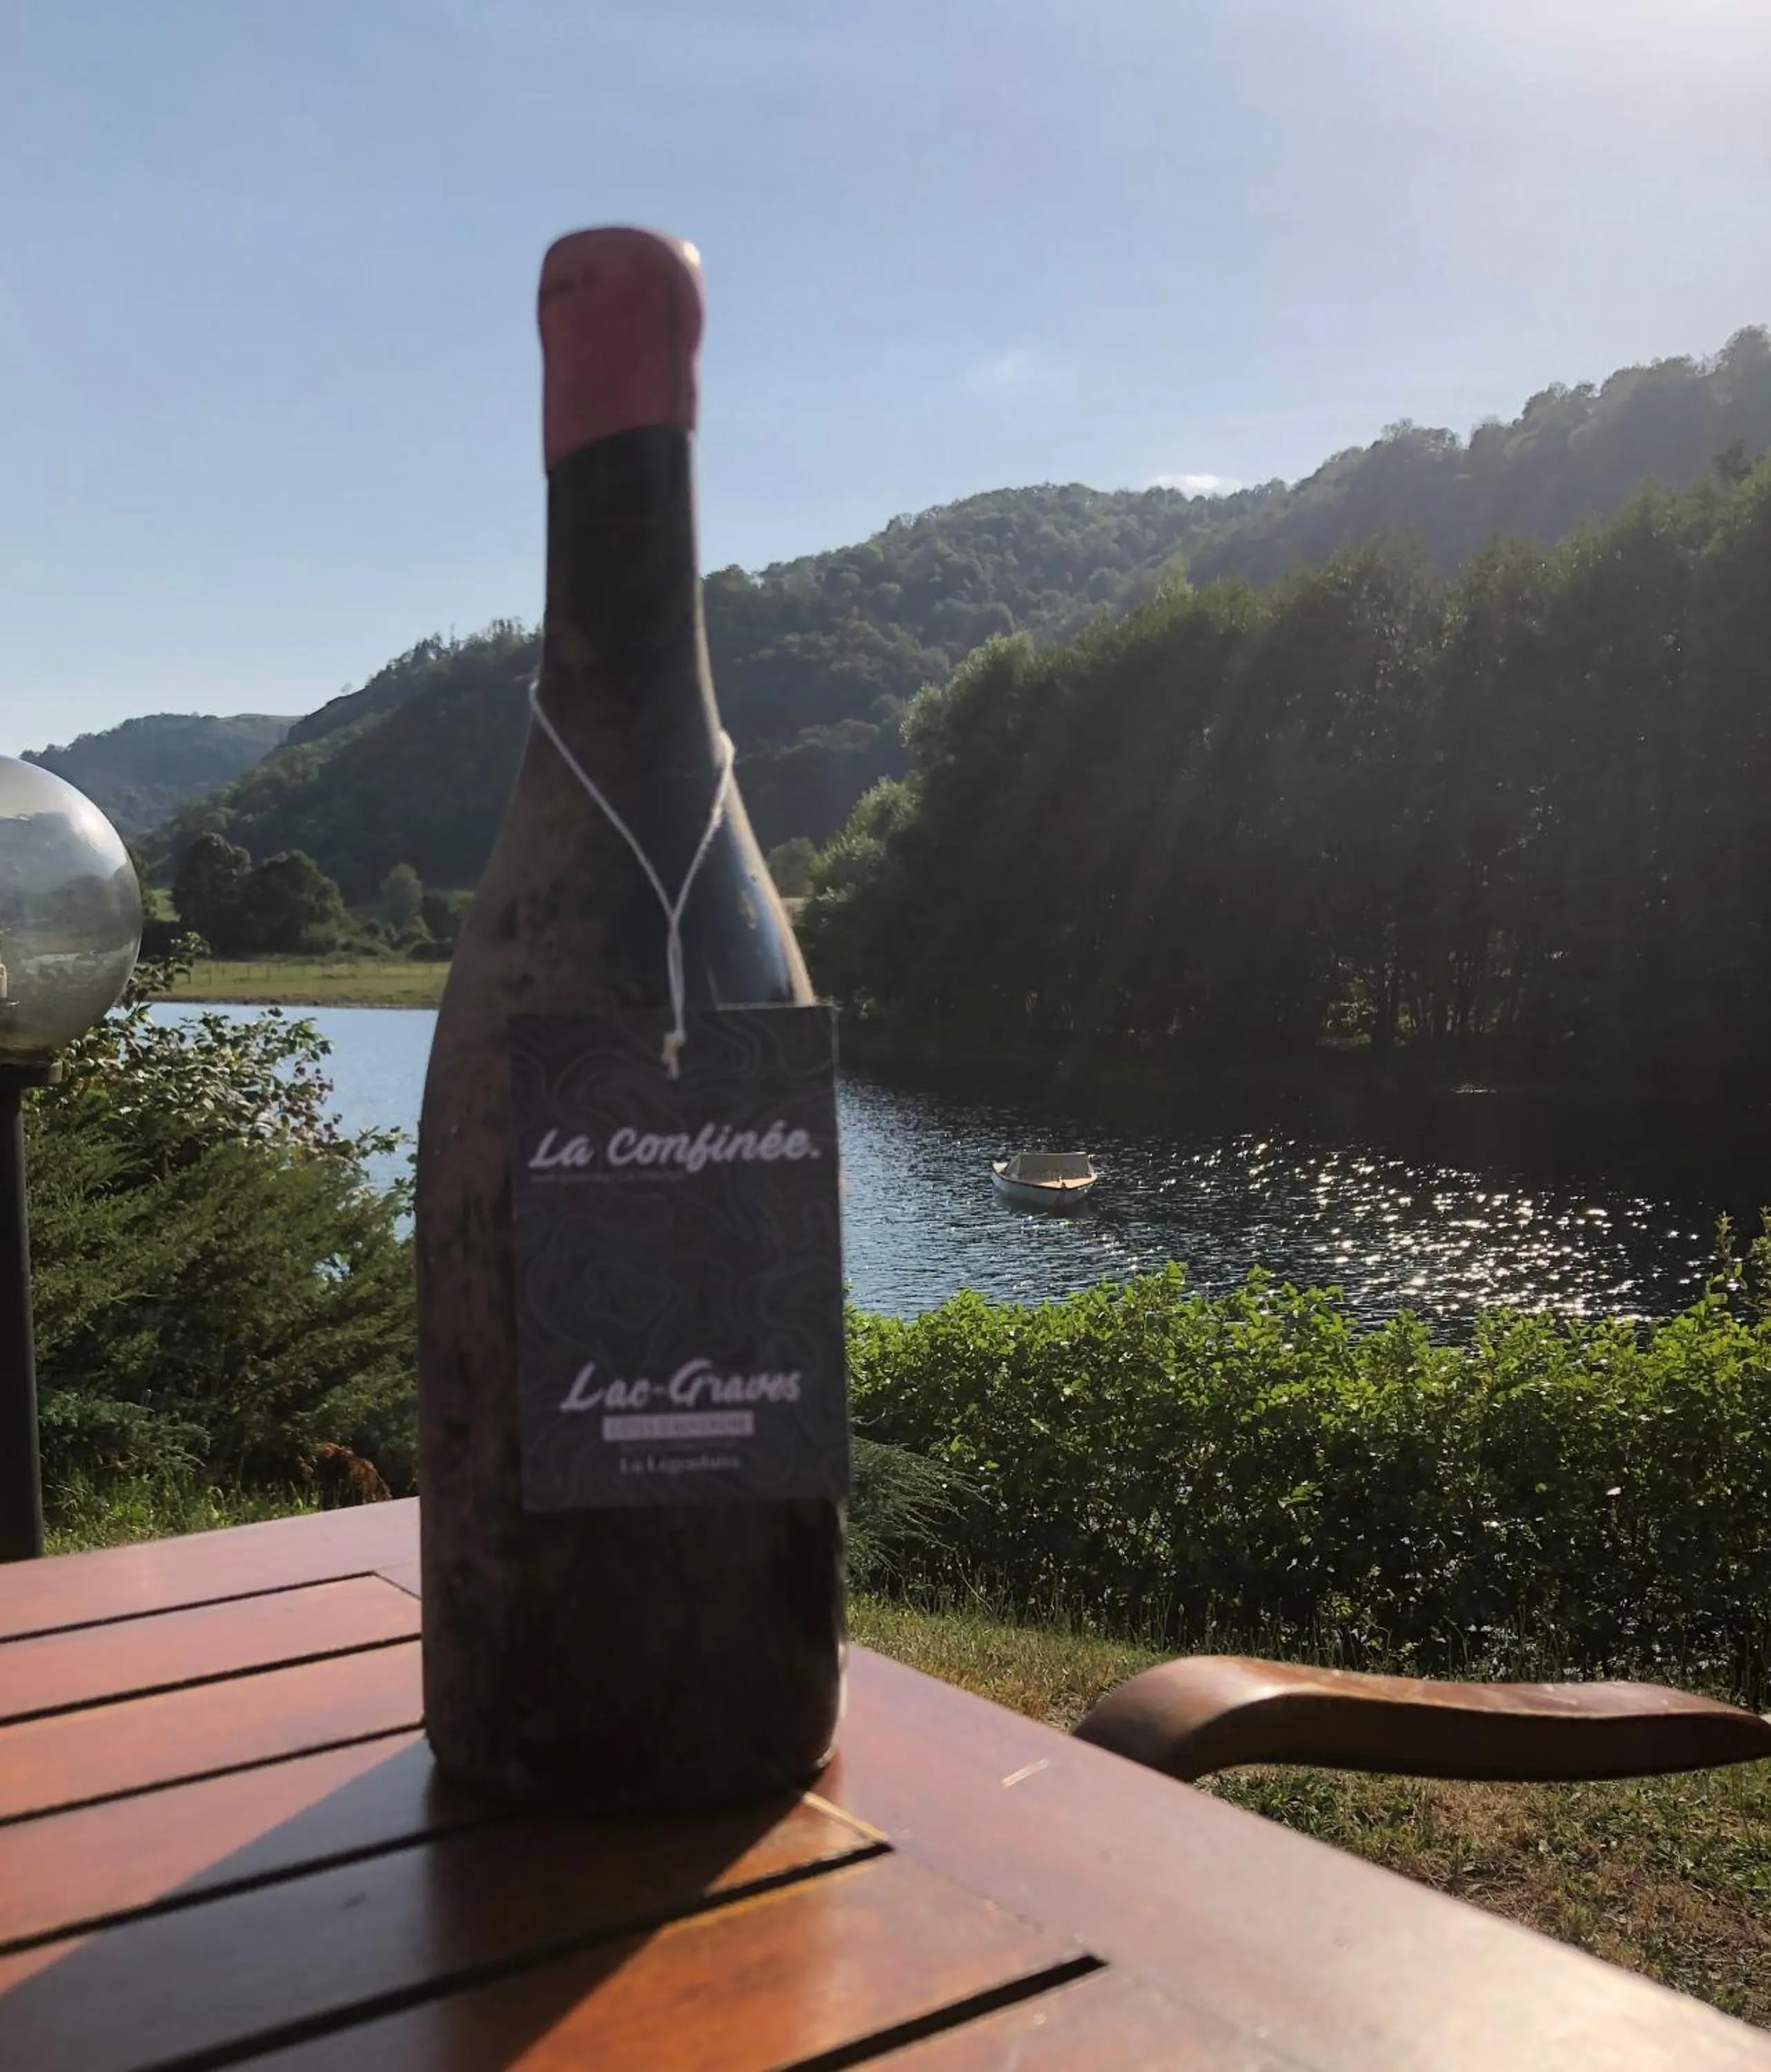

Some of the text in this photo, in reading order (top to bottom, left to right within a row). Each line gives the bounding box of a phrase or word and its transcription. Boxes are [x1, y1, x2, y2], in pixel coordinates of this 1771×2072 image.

[528, 1120, 822, 1173] La Confinée.
[559, 1358, 803, 1413] Lac-Graves
